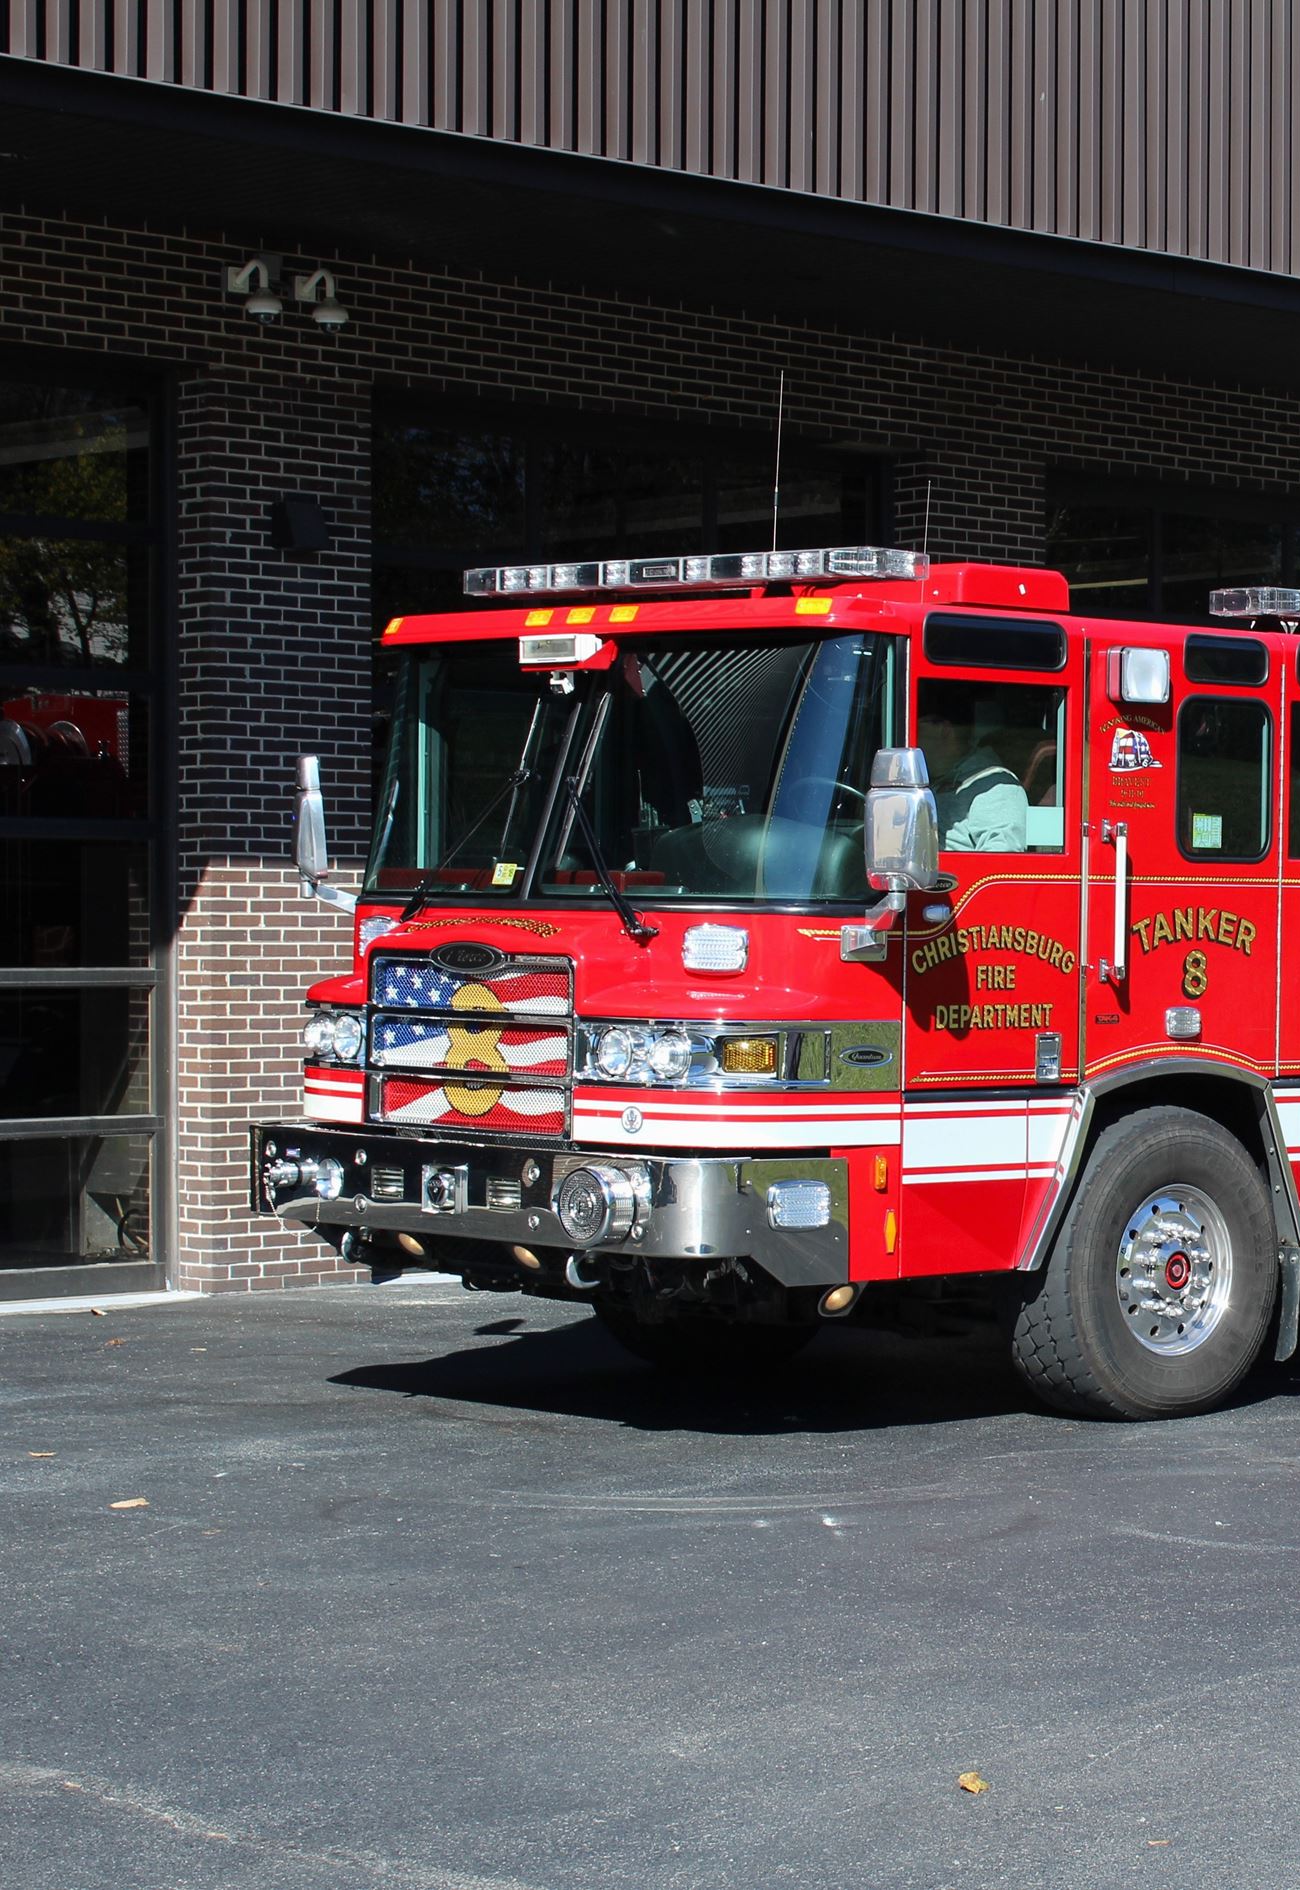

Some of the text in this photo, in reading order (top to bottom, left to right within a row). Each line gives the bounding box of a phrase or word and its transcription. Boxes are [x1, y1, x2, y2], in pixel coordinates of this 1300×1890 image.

[911, 924, 1076, 974] CHRISTIANSBURG
[1131, 907, 1257, 955] TANKER
[976, 965, 1016, 990] FIRE
[1182, 949, 1208, 999] 8
[935, 1003, 1053, 1030] DEPARTMENT
[444, 983, 509, 1116] 8
